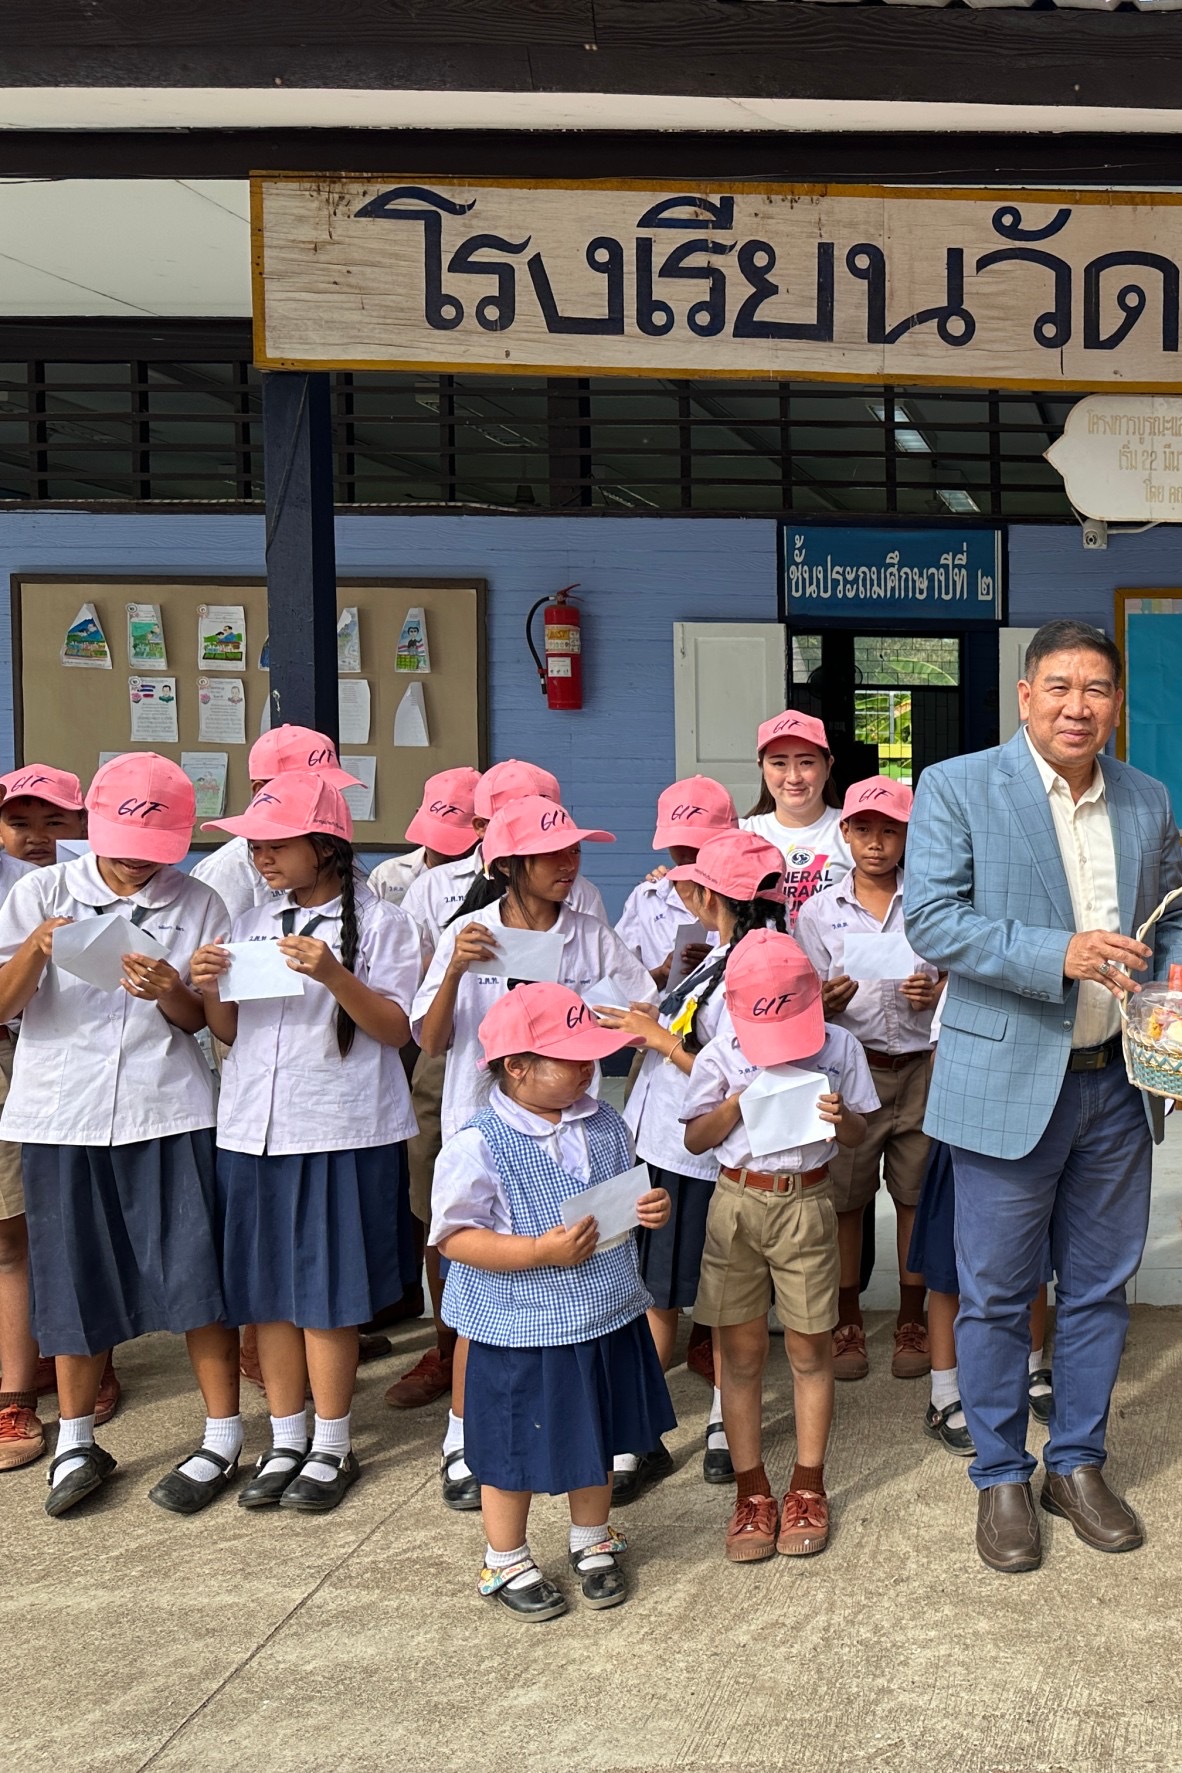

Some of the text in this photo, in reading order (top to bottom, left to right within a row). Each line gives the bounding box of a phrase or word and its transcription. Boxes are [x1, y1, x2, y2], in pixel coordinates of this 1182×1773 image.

[1141, 450, 1158, 472] 22
[789, 534, 993, 601] ชั้นประถมศึกษาปีที่ ๒
[773, 718, 806, 734] GIF
[11, 775, 56, 793] GIF
[859, 788, 895, 803] GIF
[118, 798, 169, 819] GIF
[430, 800, 464, 818] GIF
[671, 804, 709, 821] GIF
[784, 869, 833, 884] NERAL
[753, 991, 797, 1017] GIF
